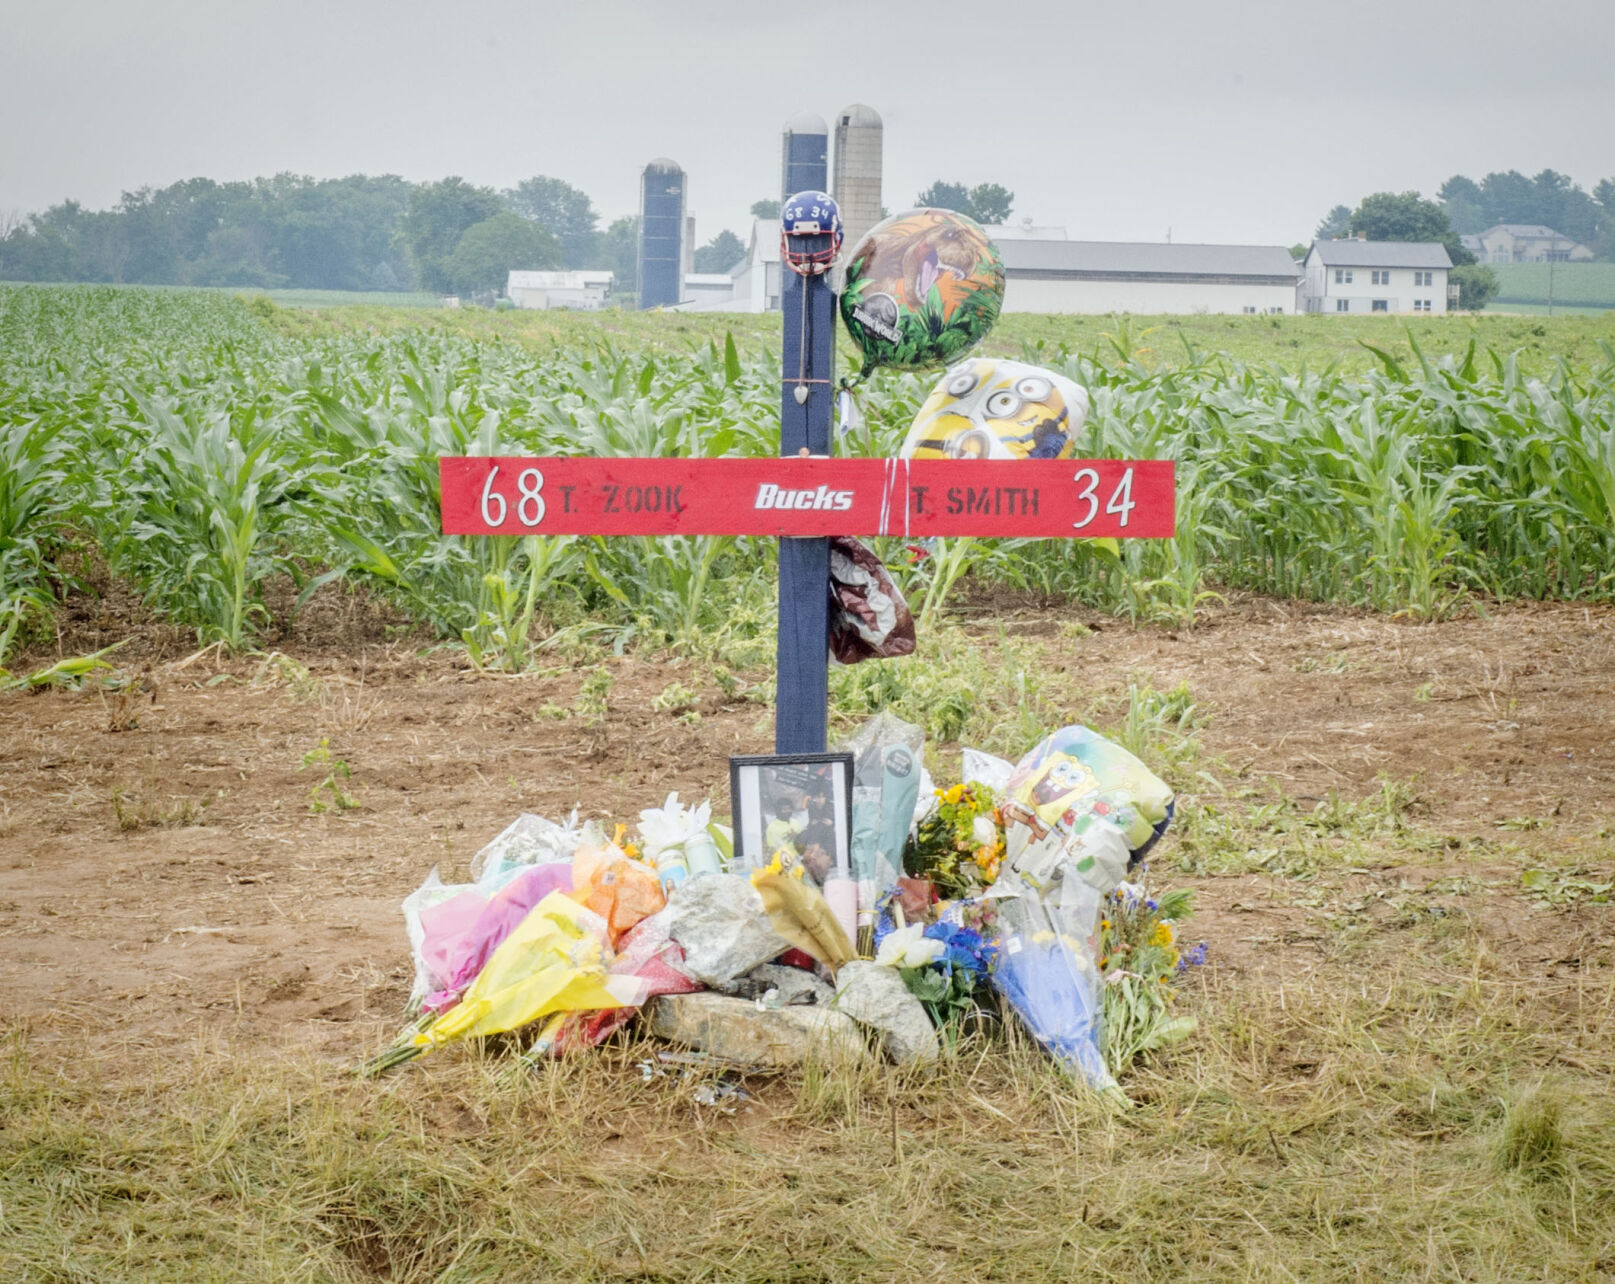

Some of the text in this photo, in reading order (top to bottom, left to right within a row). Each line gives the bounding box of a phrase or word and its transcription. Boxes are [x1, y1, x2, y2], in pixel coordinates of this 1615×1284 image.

[785, 206, 829, 220] 68 34
[481, 465, 684, 527] 68 T. ZOOK
[754, 483, 855, 511] Bucks
[912, 467, 1136, 529] T. SMITH 34
